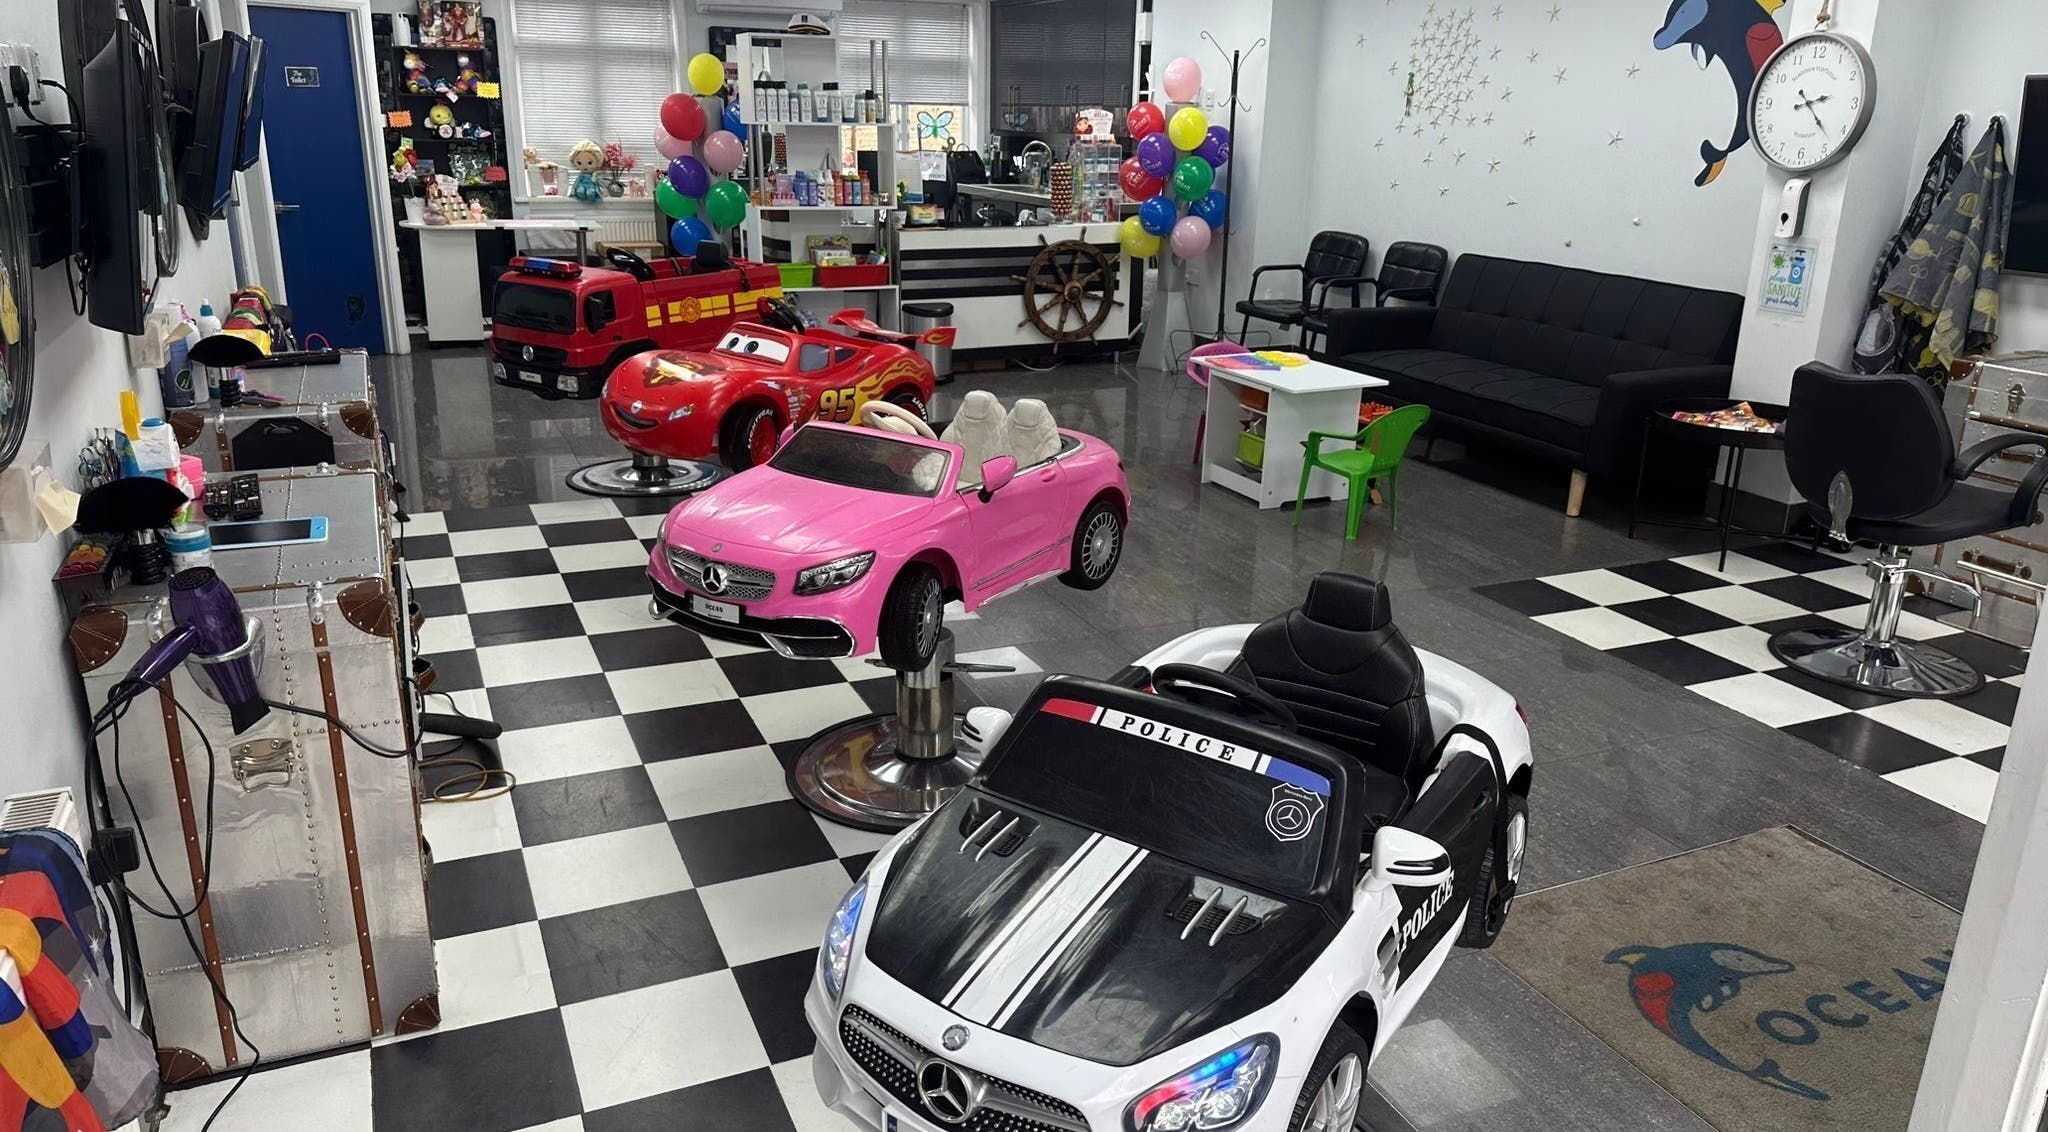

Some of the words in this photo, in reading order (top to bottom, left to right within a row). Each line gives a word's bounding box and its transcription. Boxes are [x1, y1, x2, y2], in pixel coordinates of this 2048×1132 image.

[1813, 45, 1827, 59] 12
[1793, 55, 1803, 66] 11
[1838, 54, 1843, 65] 1
[1775, 73, 1787, 84] 10
[1849, 70, 1857, 81] 2
[1765, 97, 1773, 110] 9
[1850, 97, 1859, 110] 3
[1767, 123, 1774, 134] 8
[1840, 124, 1847, 136] 4
[1779, 142, 1786, 153] 7
[1797, 147, 1805, 160] 6
[1821, 143, 1828, 154] 5
[818, 386, 855, 421] 95
[1120, 715, 1236, 762] POLICE
[1400, 869, 1455, 953] POLICE
